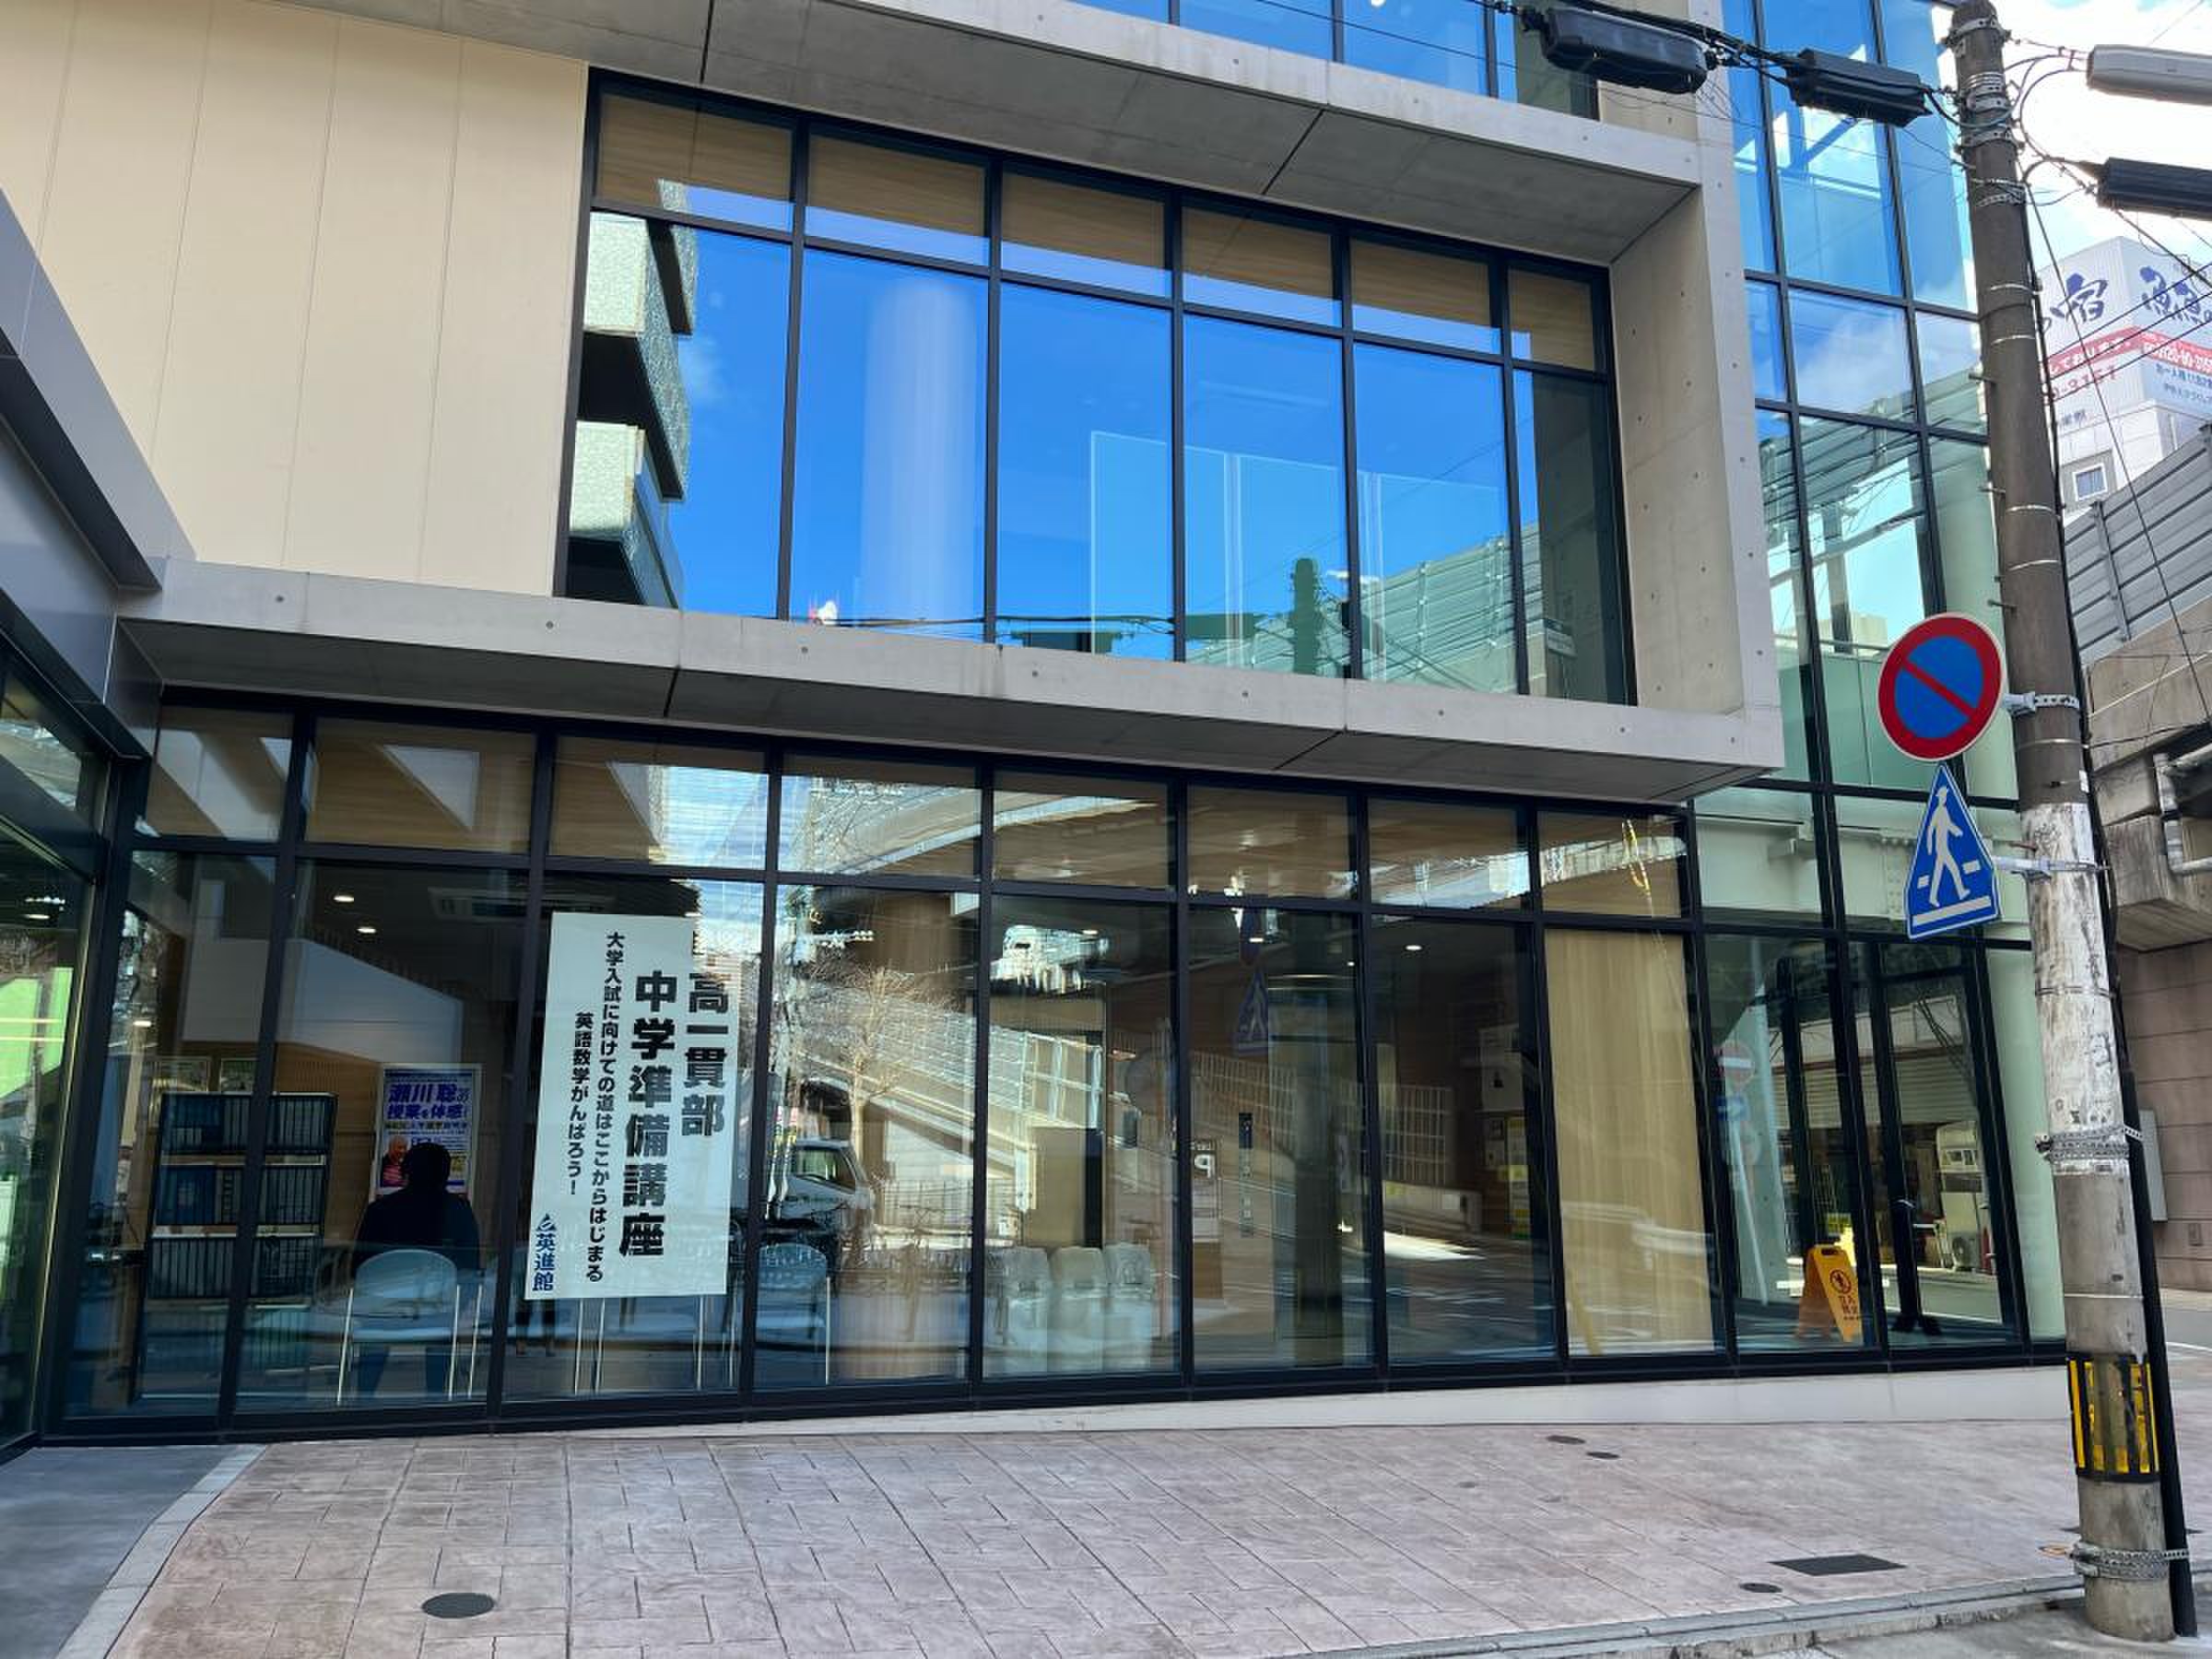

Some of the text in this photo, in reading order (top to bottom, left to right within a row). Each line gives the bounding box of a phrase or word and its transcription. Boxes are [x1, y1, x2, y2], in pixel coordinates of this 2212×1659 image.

[586, 932, 625, 1282] 大学入試に向けての道はここからはじまる
[619, 971, 677, 1256] 中学準備講座
[681, 931, 731, 1135] 高一貫部
[533, 1233, 556, 1291] 英進館
